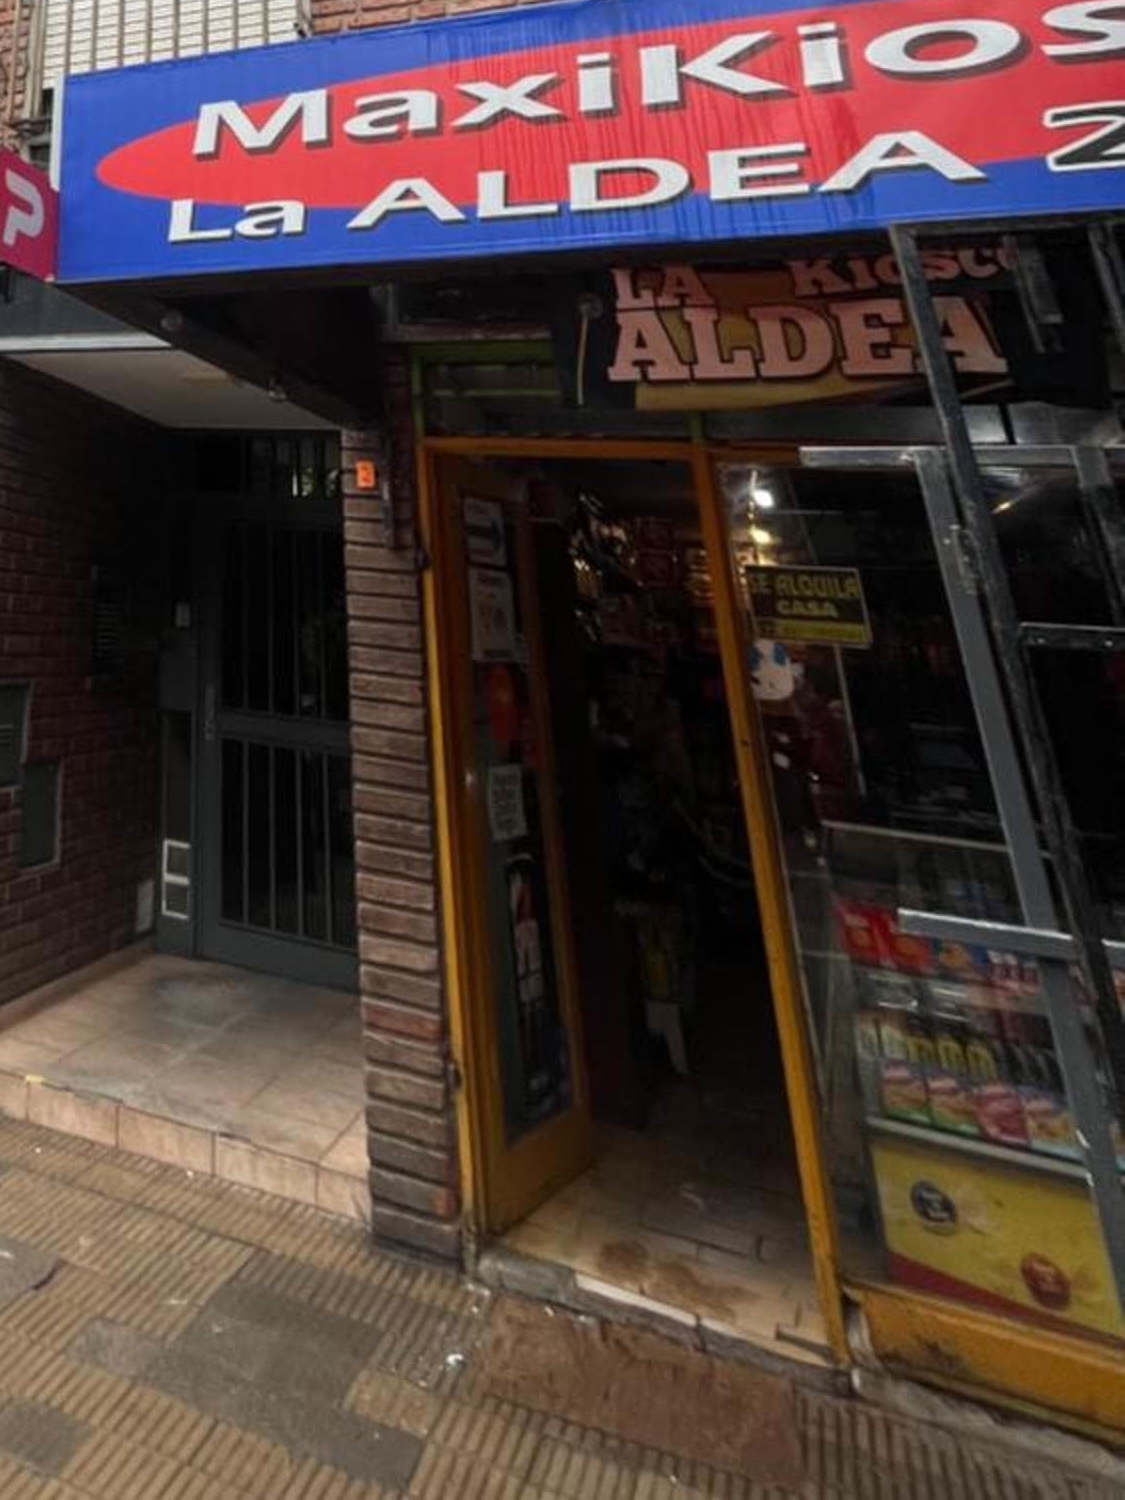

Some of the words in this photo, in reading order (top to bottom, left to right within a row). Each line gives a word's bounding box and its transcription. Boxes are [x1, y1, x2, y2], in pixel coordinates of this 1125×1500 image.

[168, 199, 306, 242] La
[346, 131, 988, 230] ALDEA
[1043, 101, 1125, 172] 2
[610, 263, 714, 306] LA
[608, 297, 1008, 381] ALDEA
